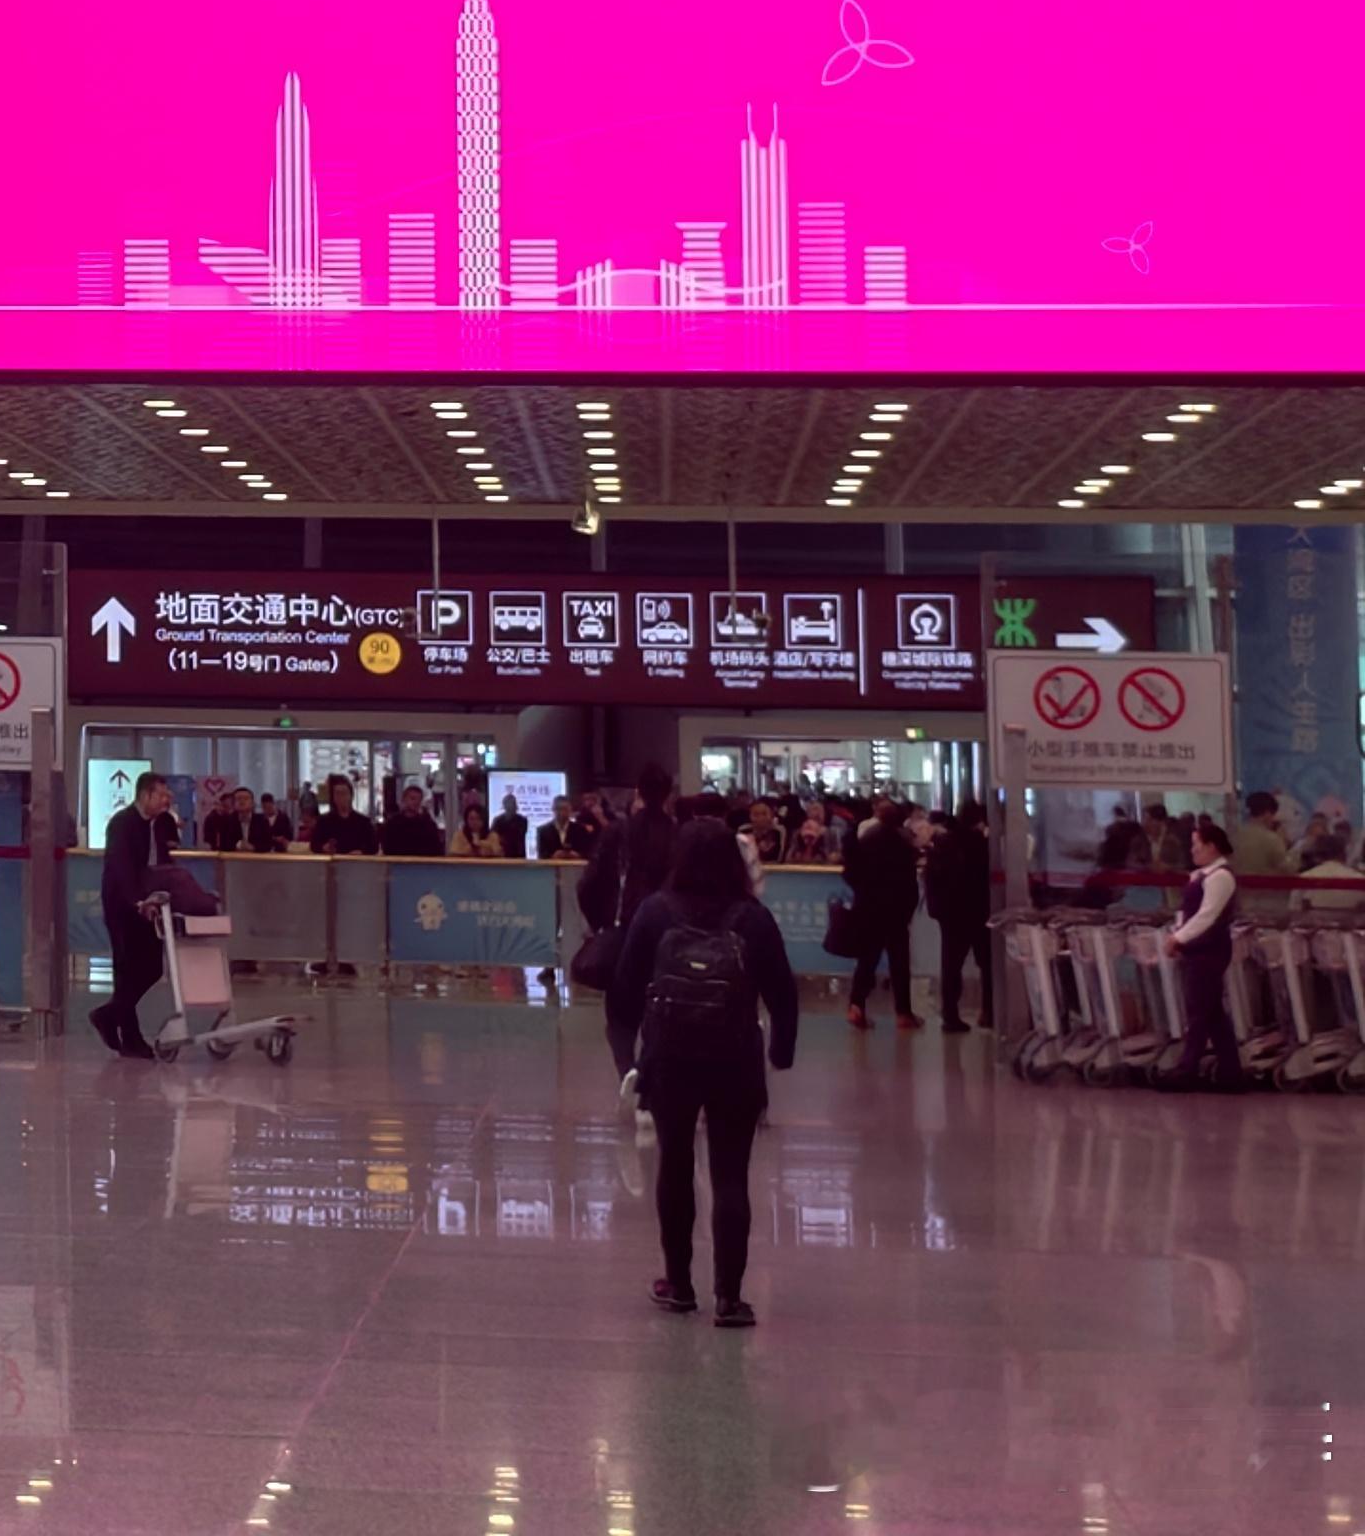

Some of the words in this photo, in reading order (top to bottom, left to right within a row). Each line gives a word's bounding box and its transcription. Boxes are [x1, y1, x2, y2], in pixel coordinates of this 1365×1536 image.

[570, 599, 613, 616] TAXI
[155, 629, 205, 642] Ground
[208, 629, 302, 645] Transportation
[305, 630, 351, 644] Center
[369, 640, 390, 655] 90
[424, 647, 468, 663] 停车场
[486, 648, 551, 664] 公交/巴士
[569, 650, 614, 665] 出租车
[642, 651, 688, 666] 网约车
[710, 651, 769, 667] 机场码头
[428, 665, 443, 675] Car
[444, 665, 464, 675] Park
